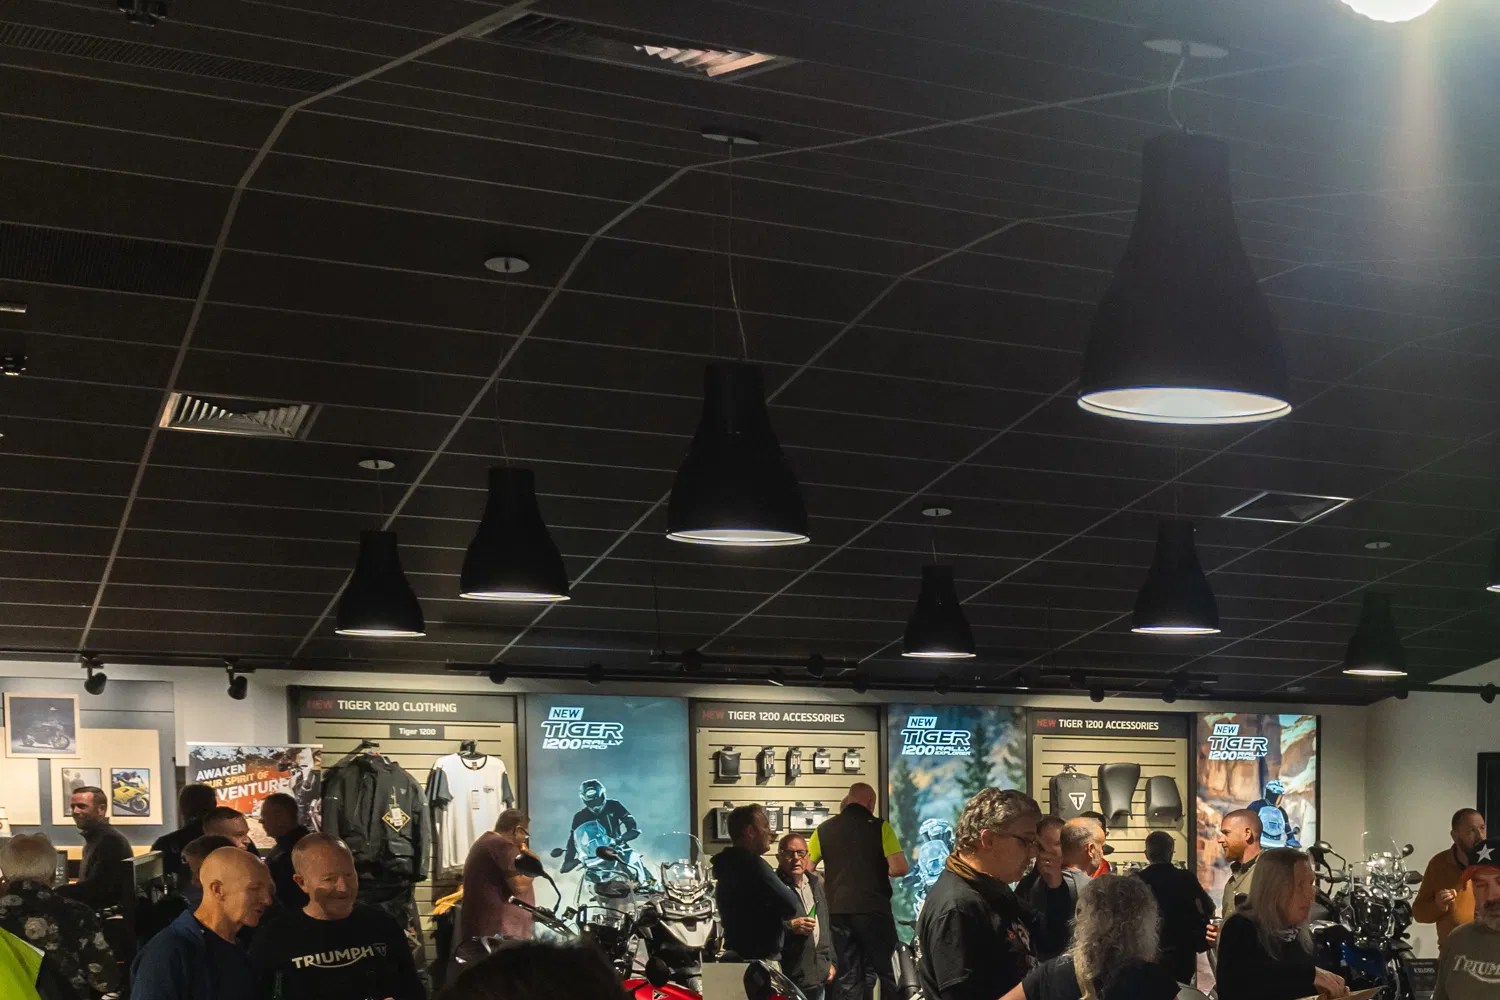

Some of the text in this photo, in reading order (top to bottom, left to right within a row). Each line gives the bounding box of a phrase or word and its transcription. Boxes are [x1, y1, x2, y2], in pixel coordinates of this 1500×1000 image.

[337, 700, 371, 711] TIGER
[375, 702, 400, 711] 1200
[403, 702, 457, 713] CLOTHING
[553, 710, 580, 718] NEW
[728, 711, 756, 721] TIGER
[759, 713, 780, 721] 1200
[783, 713, 845, 723] ACCESSORIES
[911, 719, 933, 727] NEW
[1036, 719, 1160, 731] NEW TIGER 1200 ACCESSORIES
[398, 728, 418, 736] Tiger
[541, 721, 624, 739] TIGER
[901, 729, 971, 745] TIGER
[543, 739, 582, 749] 1200
[1208, 736, 1268, 751] TIGER
[902, 745, 935, 755] 1200
[1208, 751, 1238, 760] 1200
[196, 764, 246, 781] AWAKEN
[225, 773, 255, 786] SPIRIT
[257, 770, 270, 780] OF
[291, 945, 376, 969] TRIUMPH
